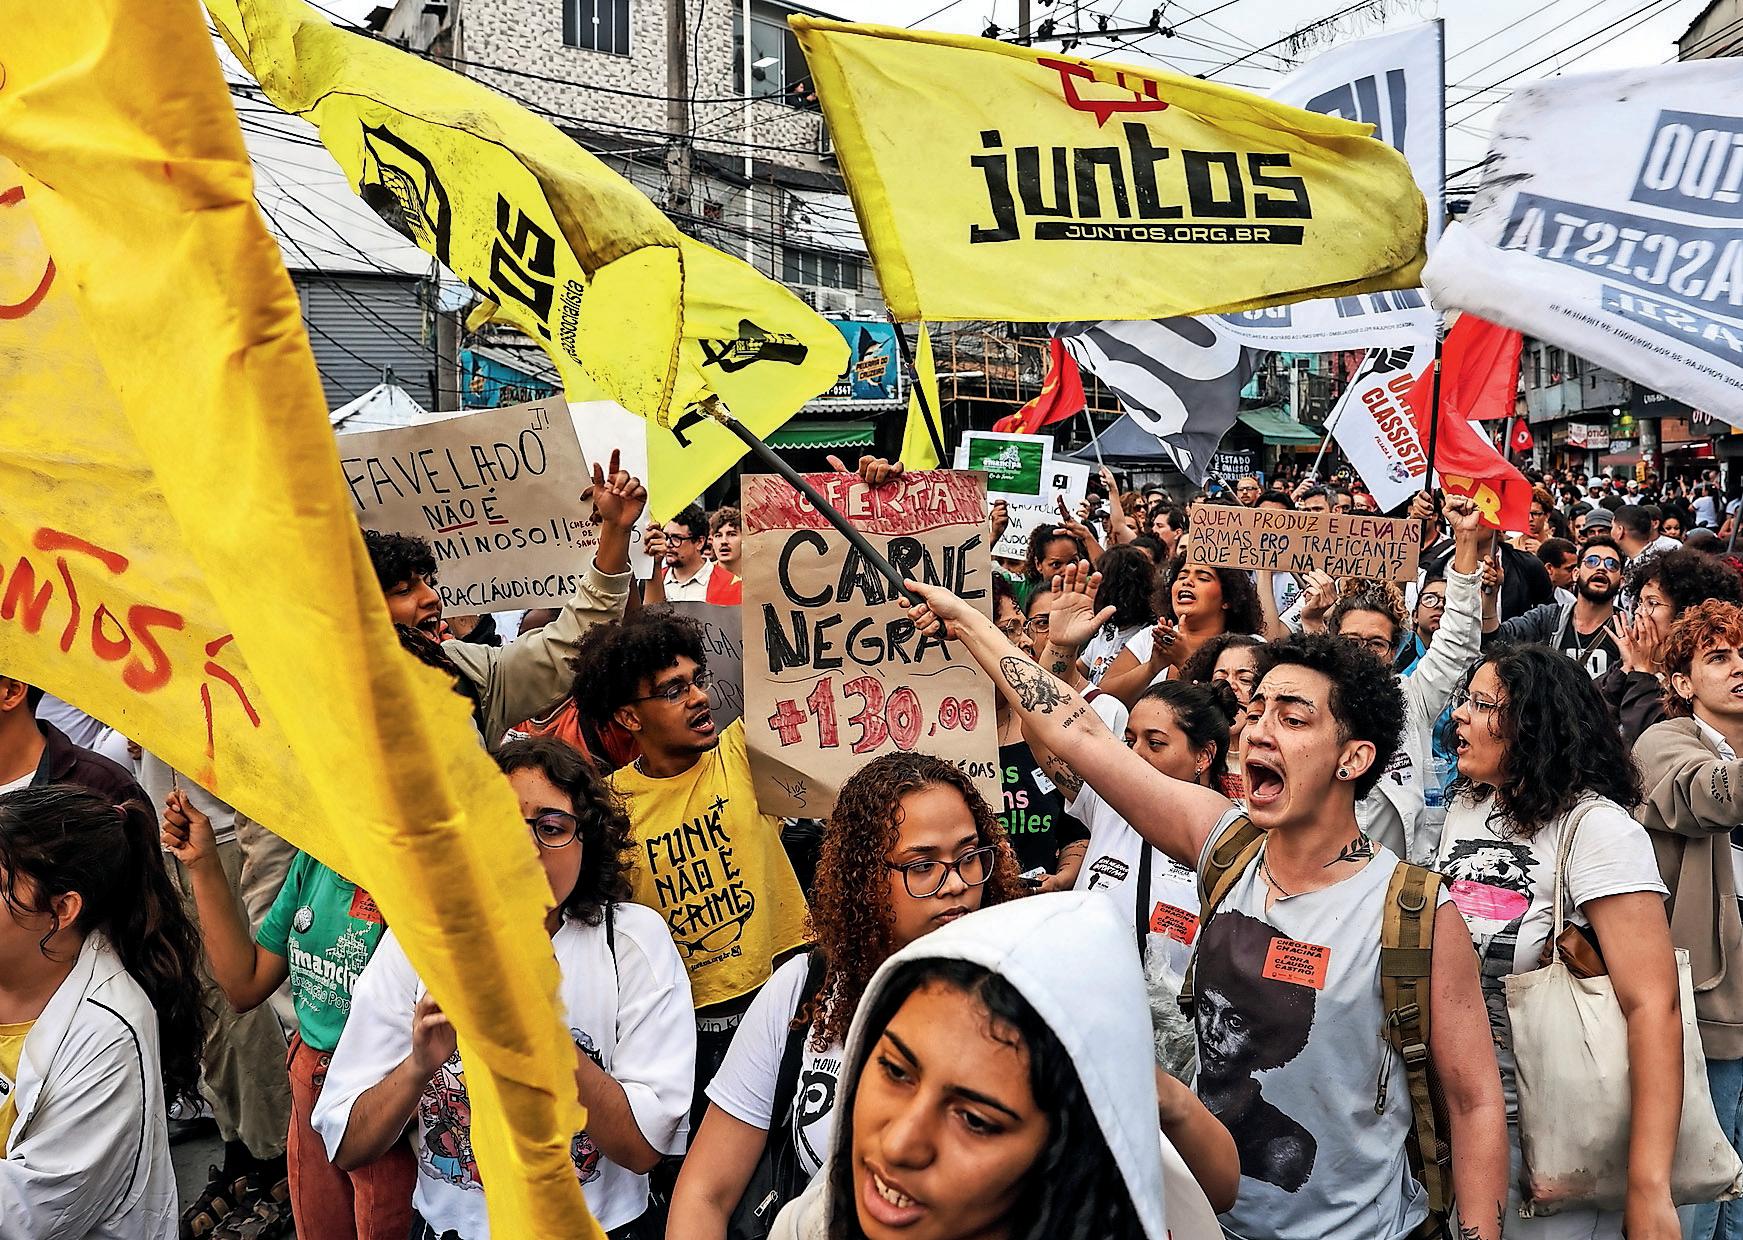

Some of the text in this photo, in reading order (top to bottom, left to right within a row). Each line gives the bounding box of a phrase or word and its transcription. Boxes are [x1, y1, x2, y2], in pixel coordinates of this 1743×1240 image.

[970, 122, 1312, 244] juntos
[1065, 225, 1270, 242] JUNTOS.ORG.BR
[1362, 387, 1427, 478] CLASSISTA
[341, 430, 547, 510] FAVELADO
[1220, 455, 1250, 464] ESTADO
[1222, 464, 1249, 472] OMISSO
[421, 487, 505, 531] NÃO É
[570, 520, 599, 529] CHEGA
[1192, 508, 1419, 543] QUEM PRODUZ E LEVA AS
[1192, 527, 1252, 549] ARMAS
[1260, 532, 1290, 551] PRO
[778, 530, 986, 608] CARNE
[1193, 545, 1403, 580] QUE ESTÁ NA FAVELA?
[0, 527, 185, 693] NTOS
[762, 603, 952, 675] NEGRA
[646, 810, 731, 875] FUNK
[655, 845, 740, 908] NÃO É
[667, 880, 750, 938] CRIME
[1276, 945, 1322, 958] CHACINA
[1277, 940, 1324, 953] CHEGA DE
[1284, 955, 1310, 964] FORA
[1275, 964, 1315, 976] CASTRO!
